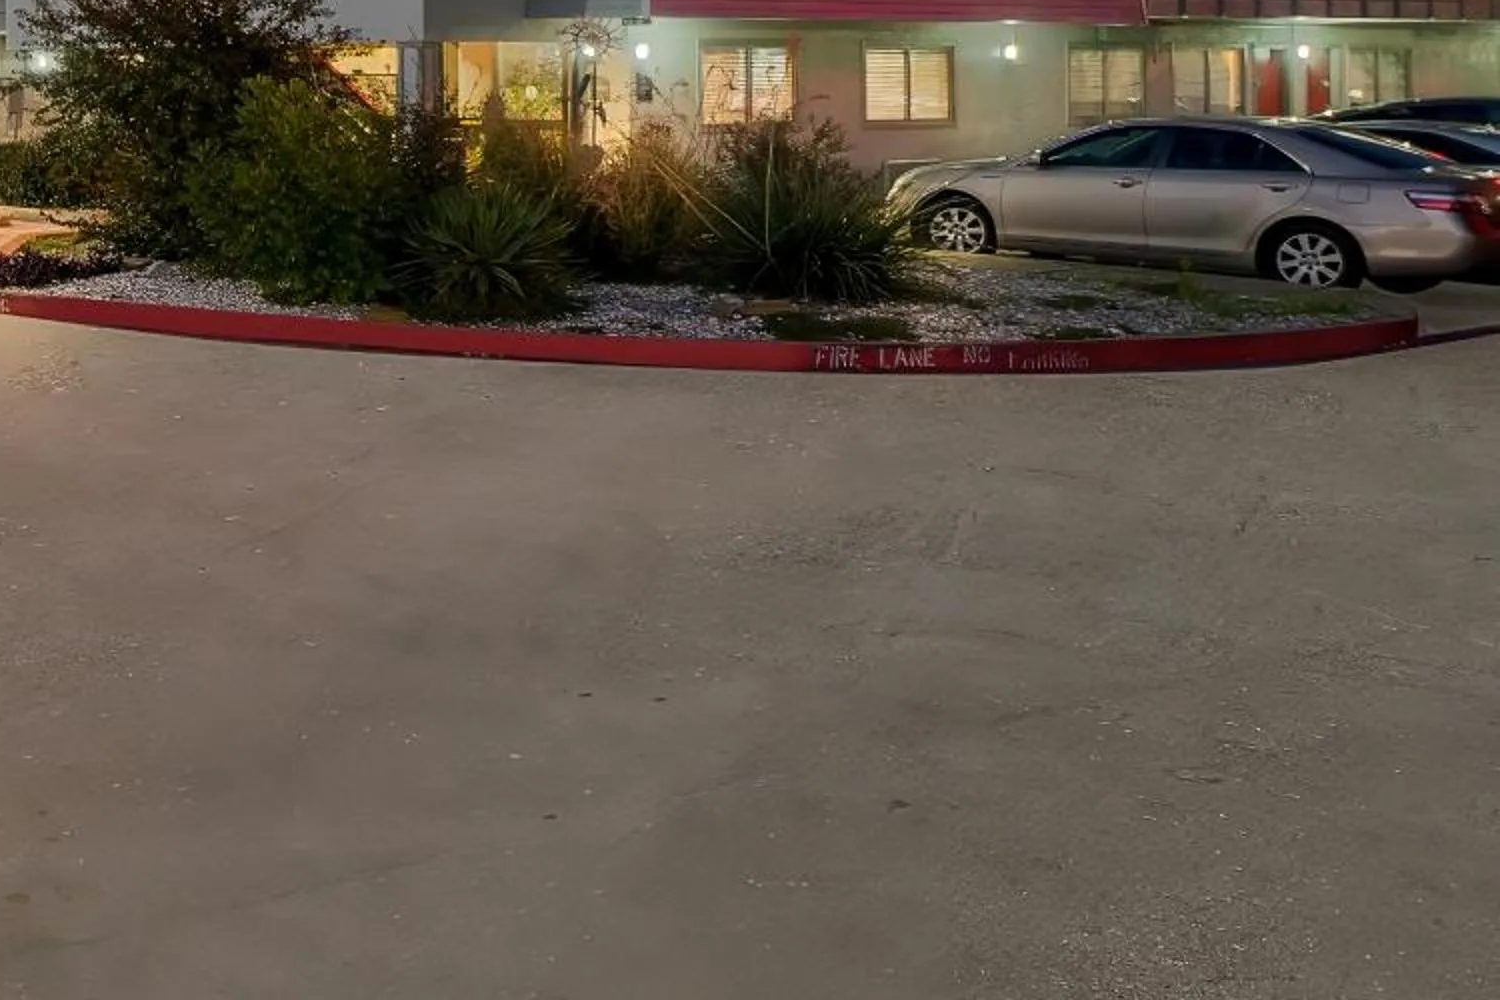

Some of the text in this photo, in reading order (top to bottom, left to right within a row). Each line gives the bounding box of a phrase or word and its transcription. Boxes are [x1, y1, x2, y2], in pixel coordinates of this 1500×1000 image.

[814, 345, 861, 369] FIRE
[879, 346, 937, 370] LANE
[963, 345, 991, 364] NO
